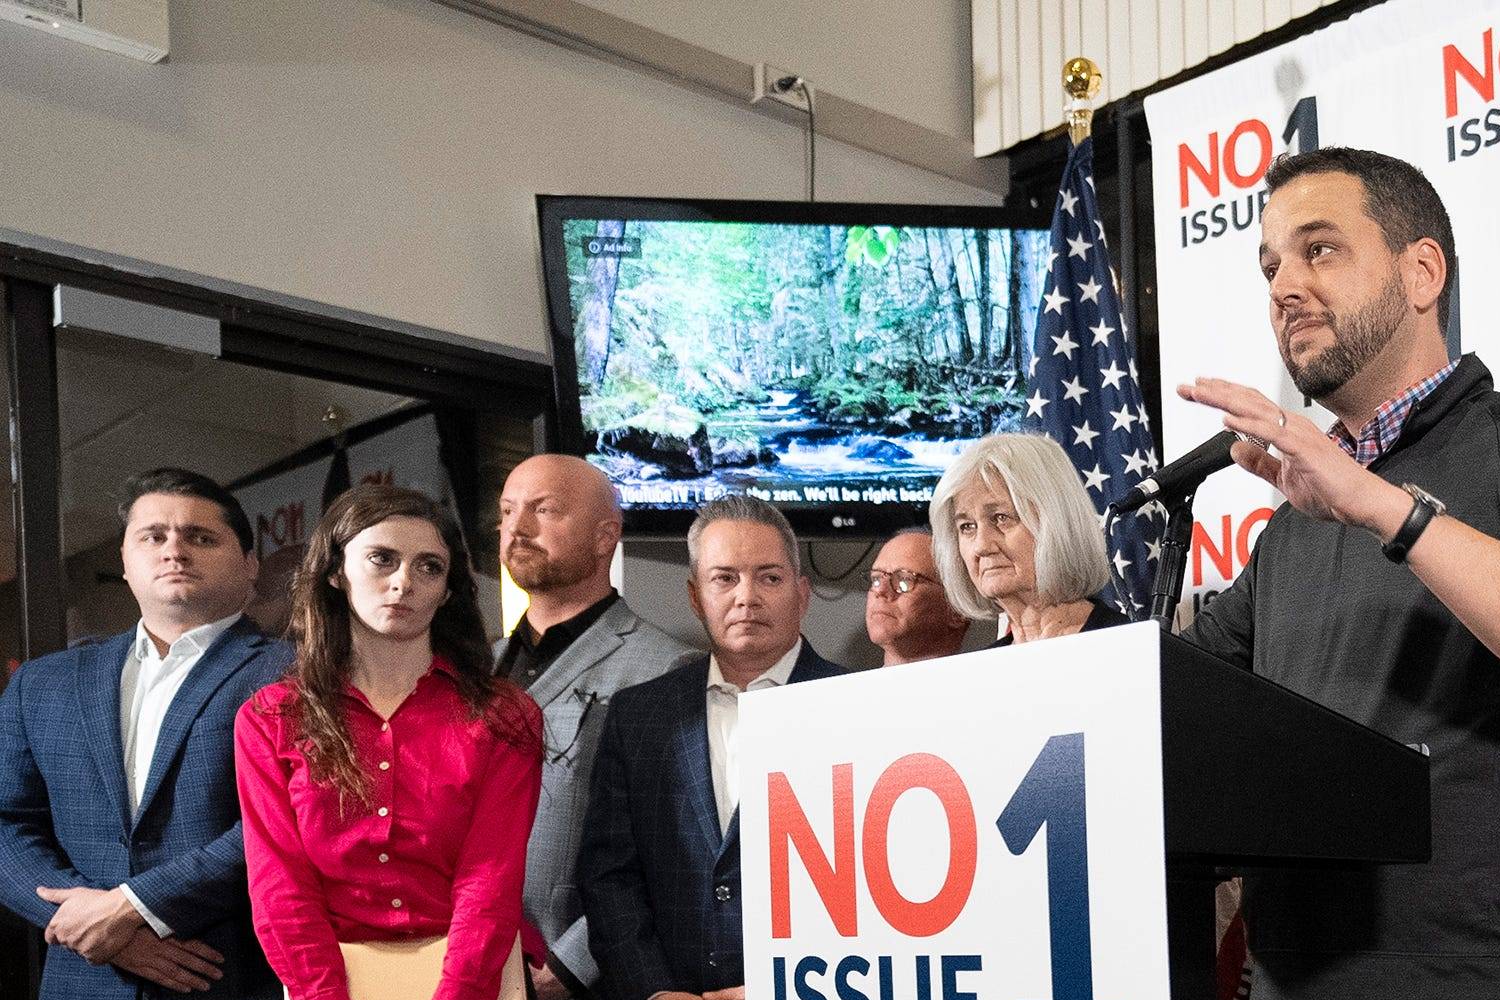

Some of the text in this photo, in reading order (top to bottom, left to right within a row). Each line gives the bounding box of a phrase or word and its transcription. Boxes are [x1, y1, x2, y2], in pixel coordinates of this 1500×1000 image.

[1178, 118, 1273, 209] NO
[842, 486, 860, 501] be
[768, 752, 977, 938] NO
